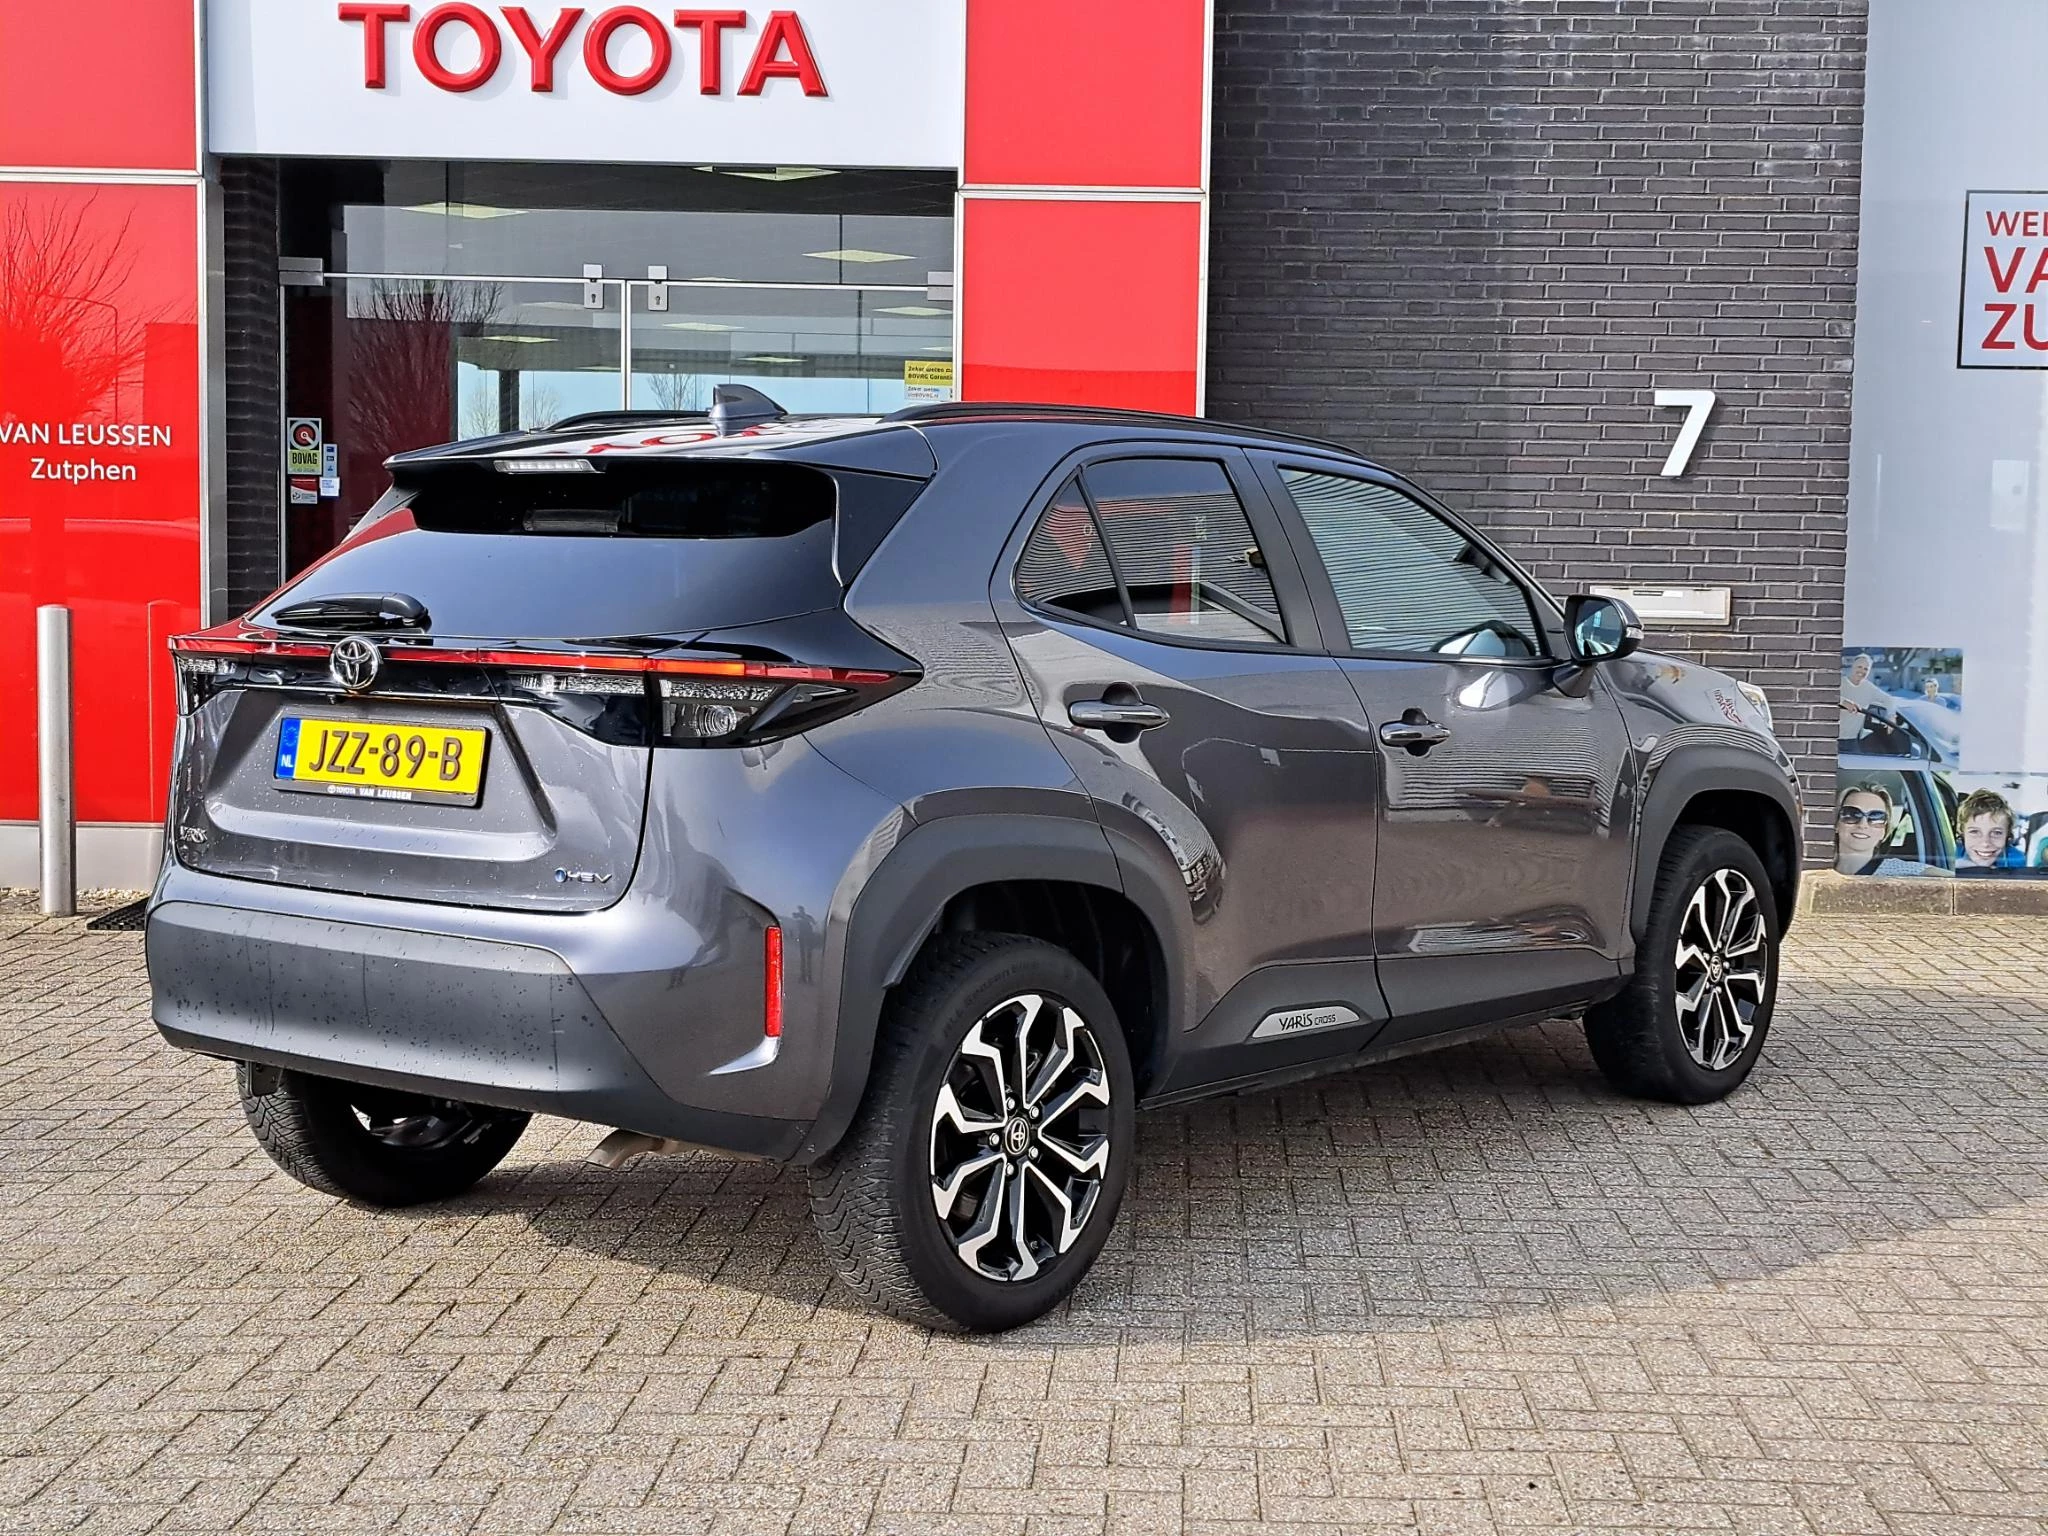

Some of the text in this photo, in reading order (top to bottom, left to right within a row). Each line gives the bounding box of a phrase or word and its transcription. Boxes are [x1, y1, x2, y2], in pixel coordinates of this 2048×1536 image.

[338, 3, 829, 98] TOYOTA
[0, 422, 171, 447] VAN LEUSSEN
[1654, 390, 1716, 477] 7
[30, 457, 137, 486] Zutphen
[291, 452, 318, 465] BOVAG
[280, 753, 294, 768] NL
[308, 729, 463, 781] JZZ-89-B
[358, 787, 375, 797] VAN
[377, 788, 413, 801] LEUSSEN
